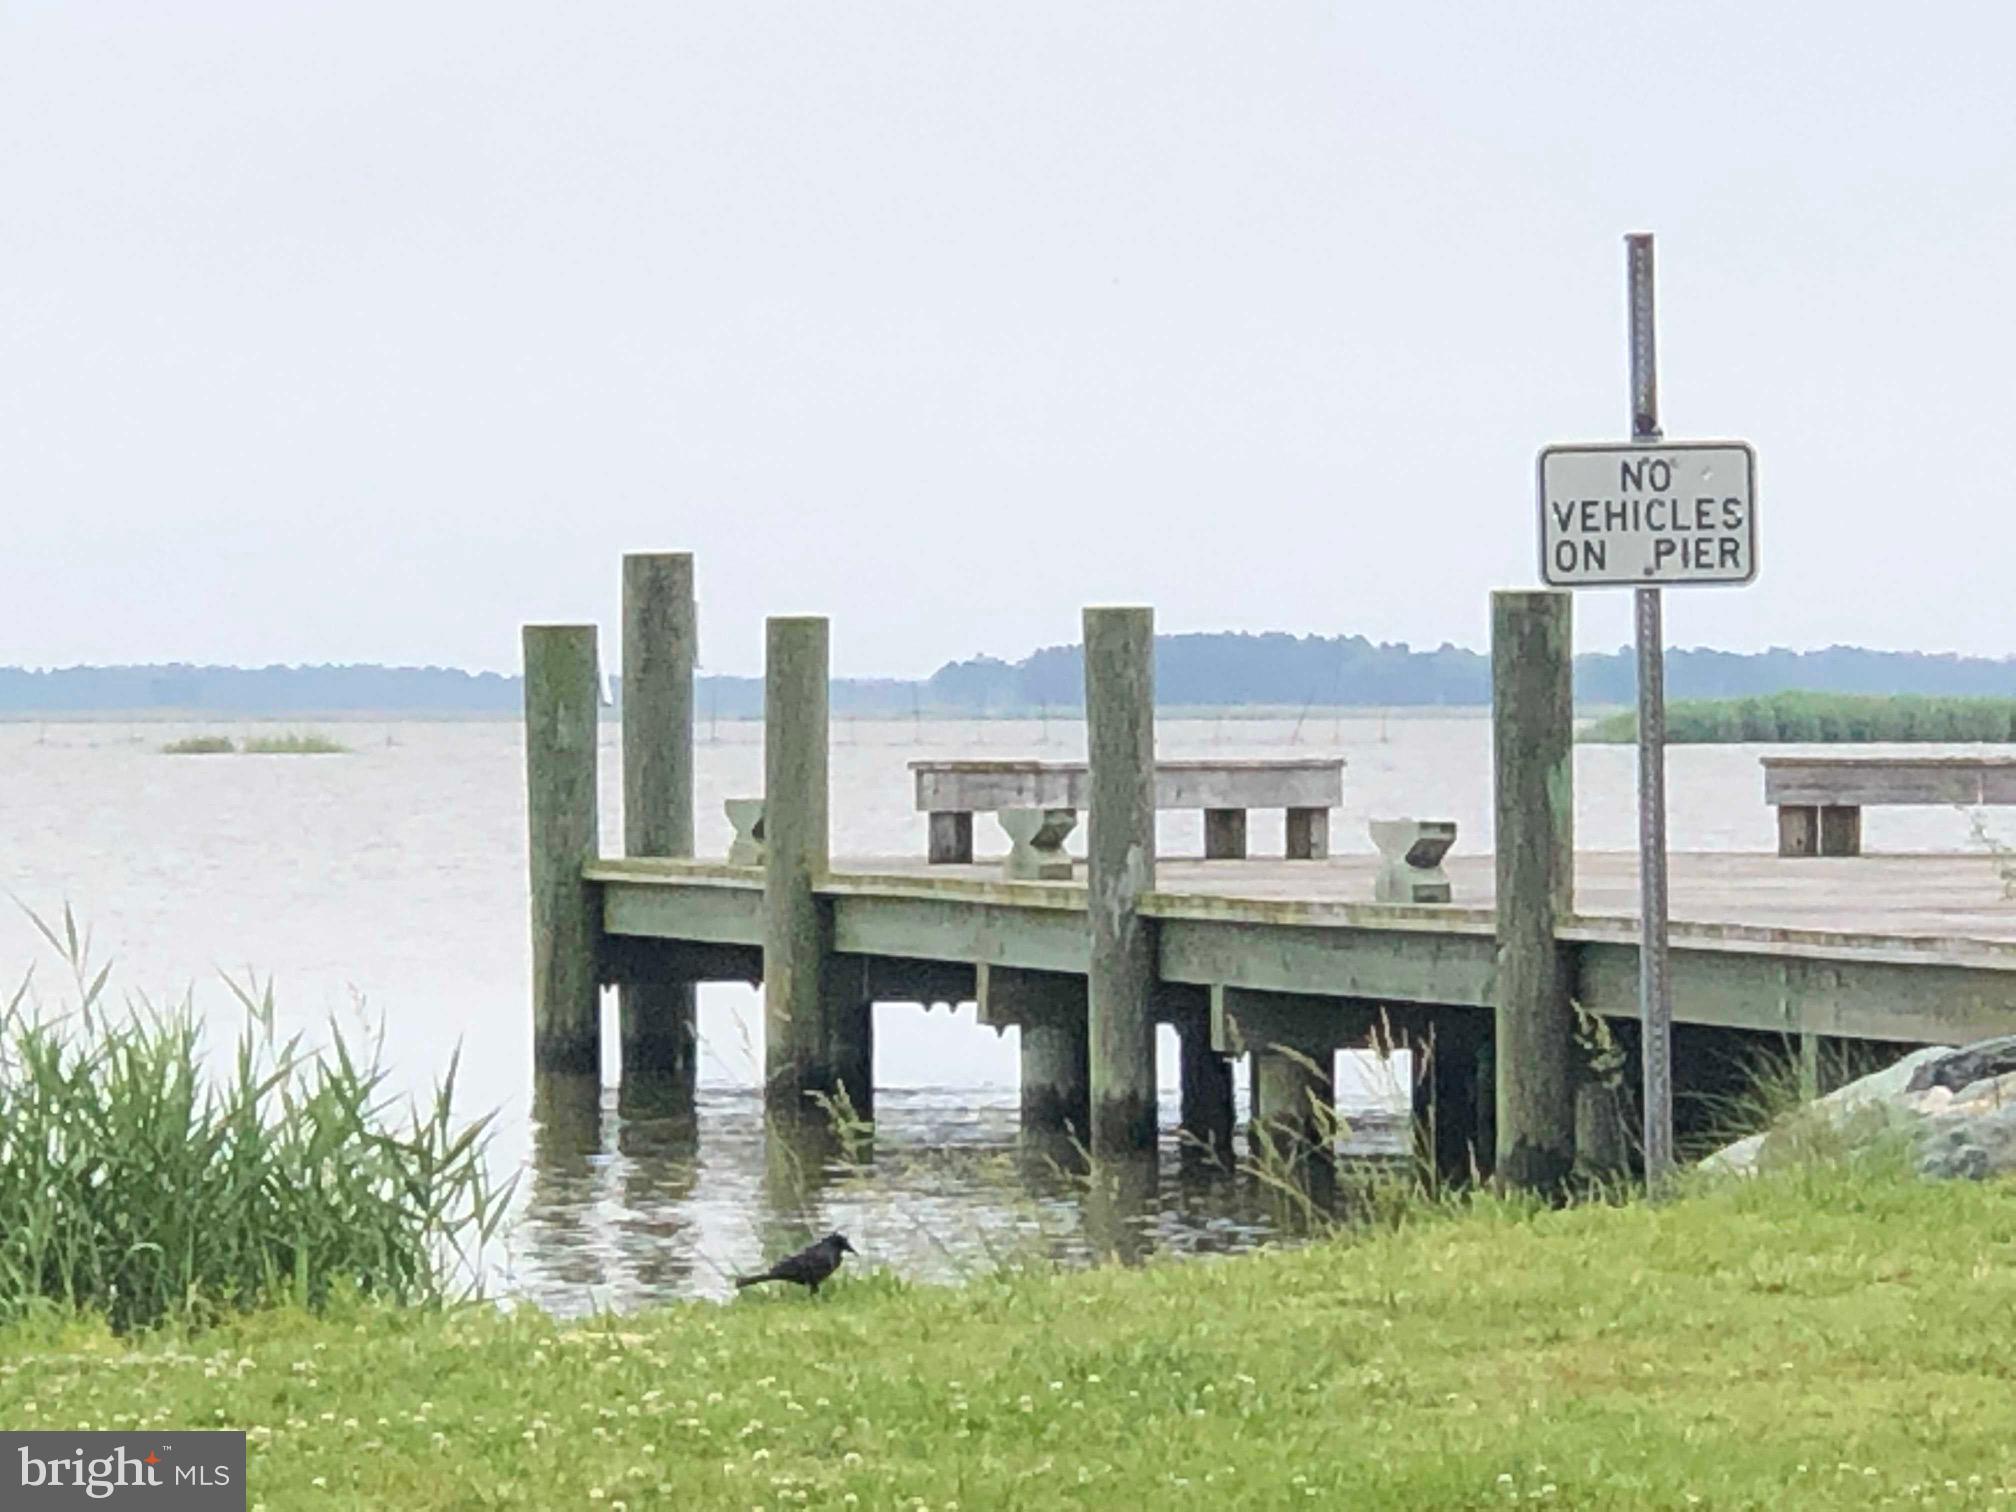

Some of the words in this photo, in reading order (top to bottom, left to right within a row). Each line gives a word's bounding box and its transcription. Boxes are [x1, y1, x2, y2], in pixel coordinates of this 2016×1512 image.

[1621, 458, 1671, 492] NO
[1552, 498, 1743, 532] VEHICLES
[1555, 539, 1605, 572] ON
[1654, 537, 1740, 570] PIER
